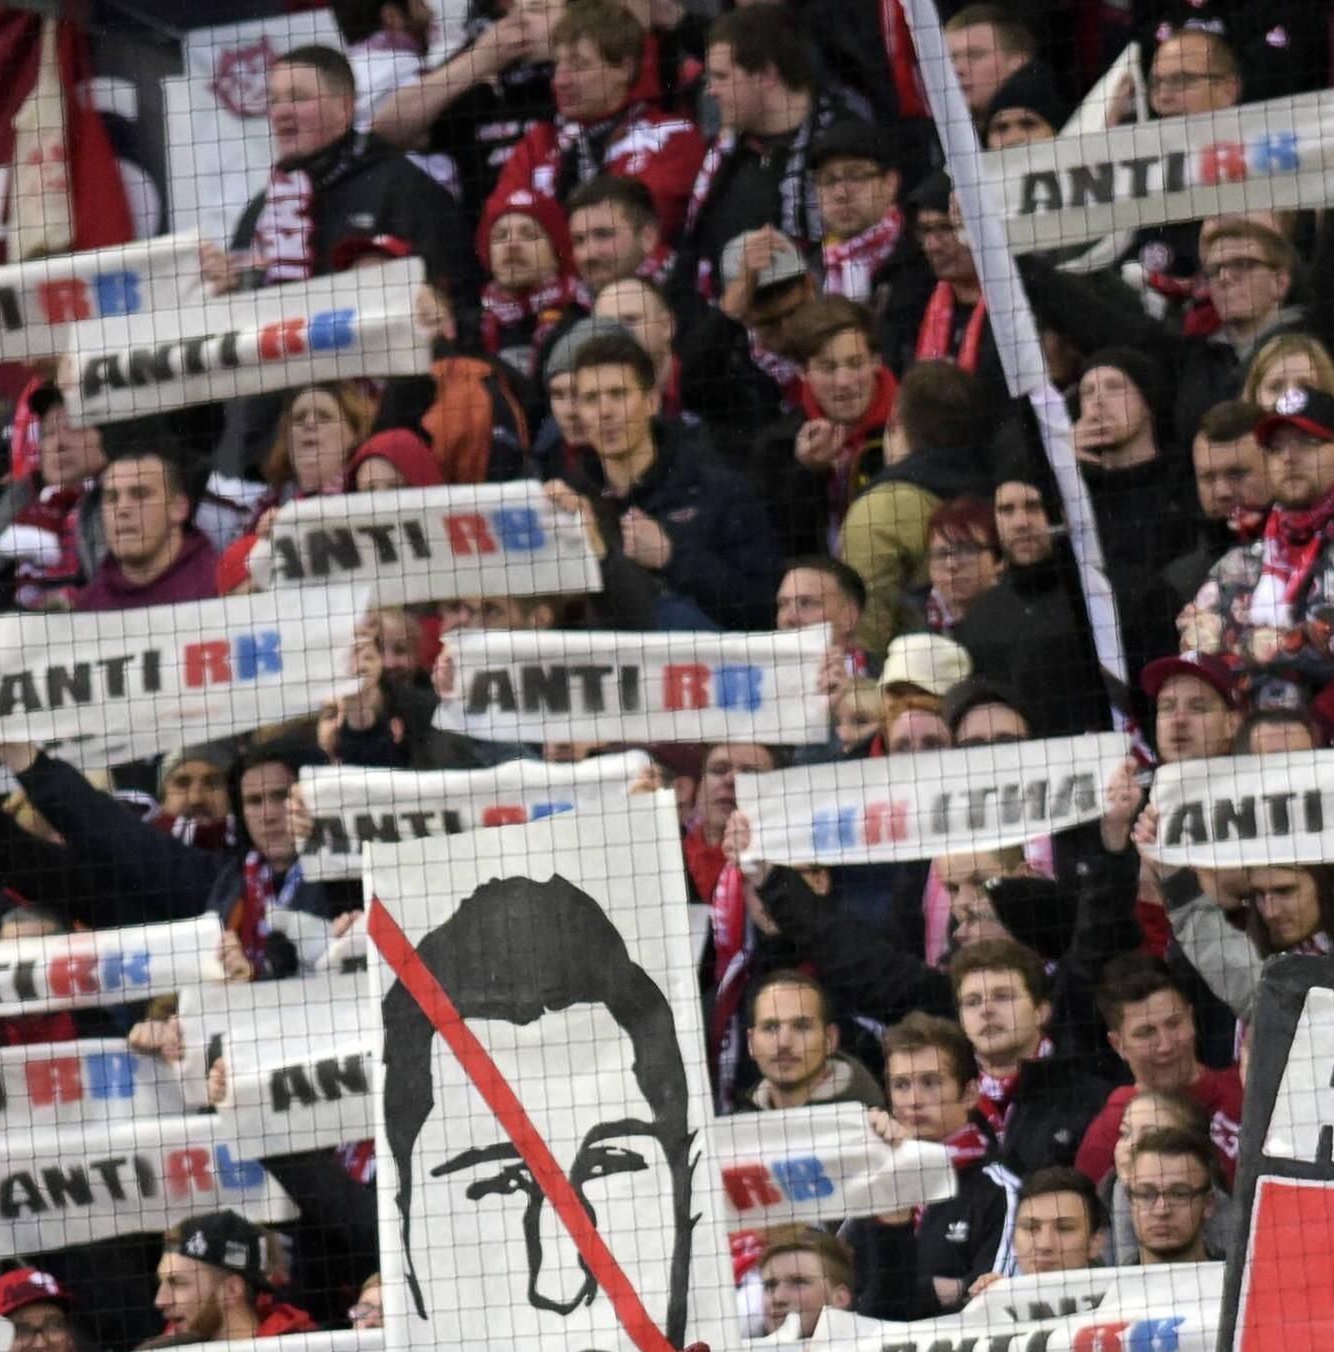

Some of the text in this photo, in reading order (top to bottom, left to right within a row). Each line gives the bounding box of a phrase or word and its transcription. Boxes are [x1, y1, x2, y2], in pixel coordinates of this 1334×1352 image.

[1019, 131, 1301, 215] ANTI RB
[38, 270, 142, 325] RB
[81, 308, 357, 398] ANTI RB
[271, 506, 545, 582] ANTI RB
[184, 631, 283, 688] RB
[467, 662, 763, 715] ANTI RB
[1165, 790, 1324, 845] ANTI
[49, 950, 150, 997] RB
[25, 1052, 139, 1106] RB
[0, 1143, 266, 1218] ANTI RB
[722, 1154, 836, 1214] RB
